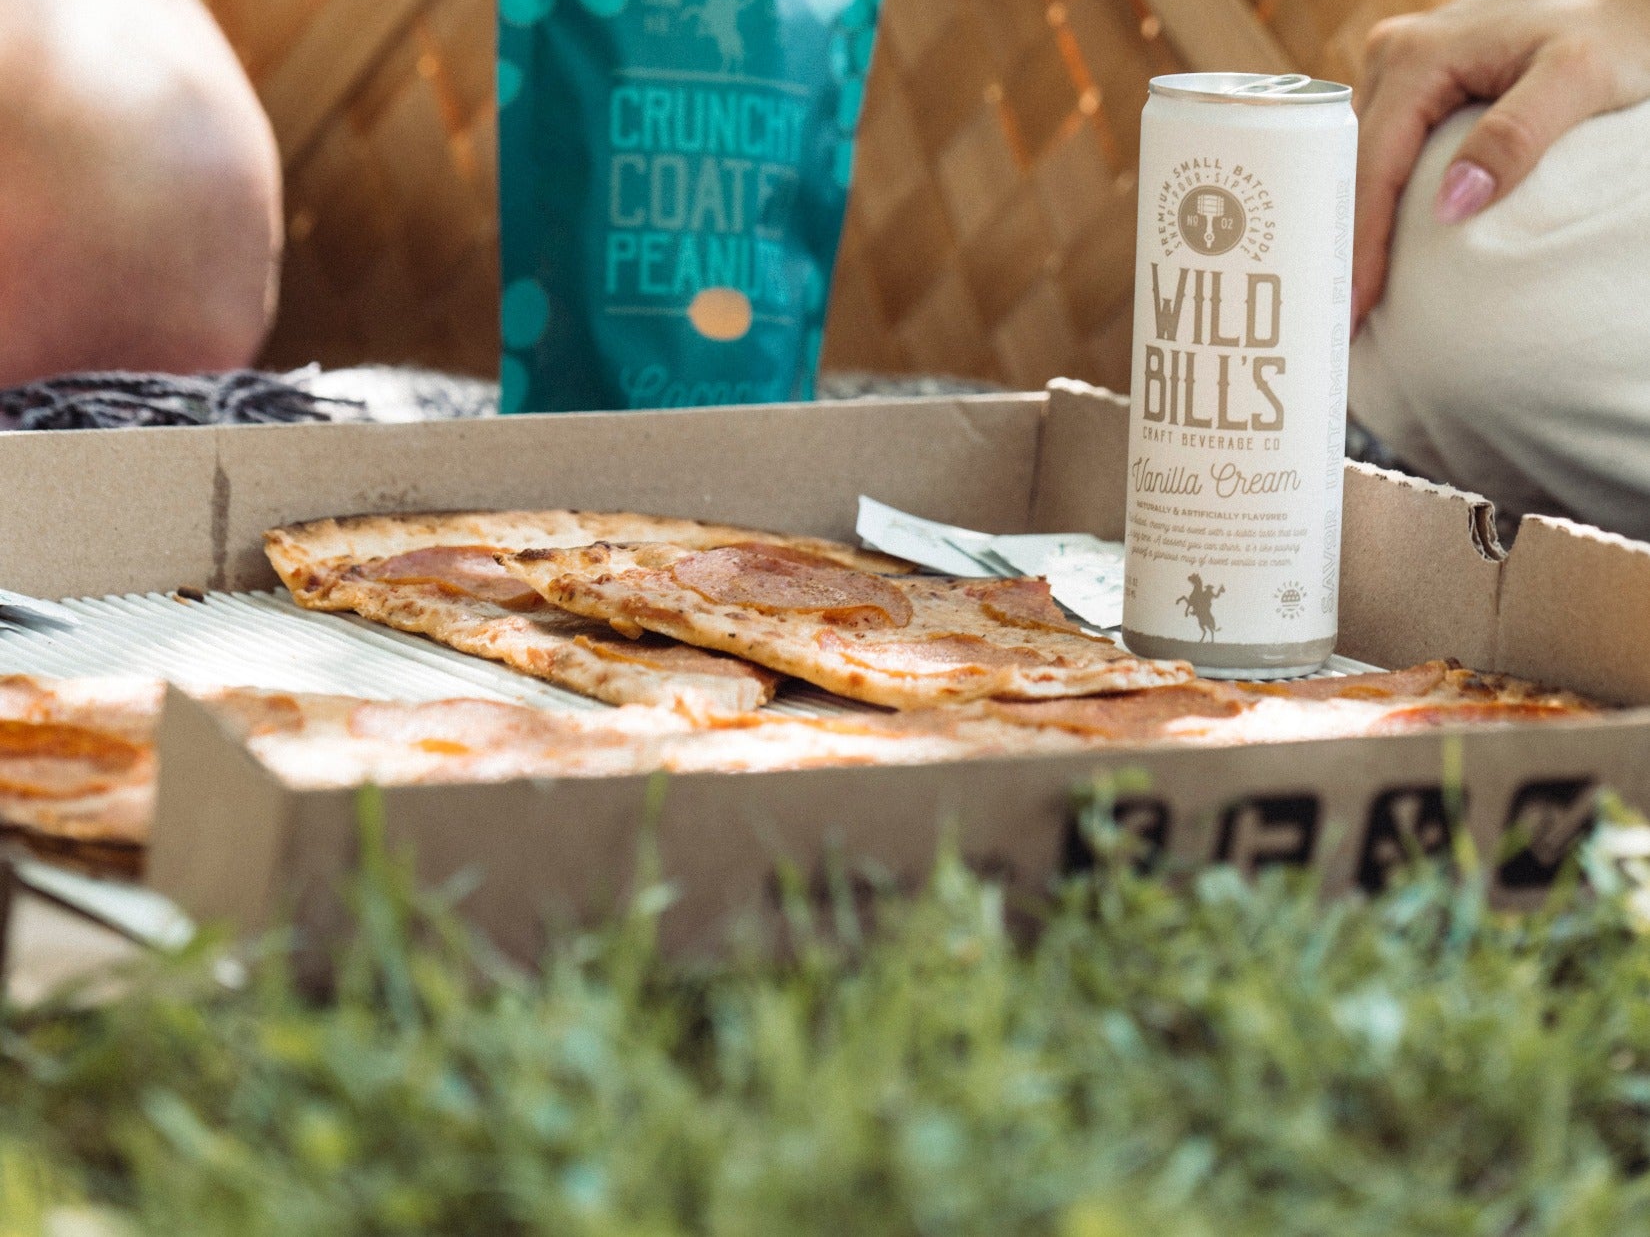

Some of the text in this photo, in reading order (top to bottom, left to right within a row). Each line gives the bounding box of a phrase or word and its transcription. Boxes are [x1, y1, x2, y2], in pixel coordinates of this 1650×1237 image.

[1158, 157, 1276, 262] PREMIUM SMALL BATCH SODA
[1167, 172, 1261, 254] SNAP POUR SIP ESCAPE
[1221, 218, 1234, 230] 02
[1151, 263, 1283, 349] WILD
[1142, 344, 1286, 432] BILL'S
[1142, 426, 1281, 451] CRAFT BEVERAGE CO
[1132, 456, 1301, 498] Vanilla Cream
[1173, 507, 1179, 515] &
[1181, 508, 1239, 520] ARTIFICIALLY
[1242, 513, 1288, 521] FLAVORED
